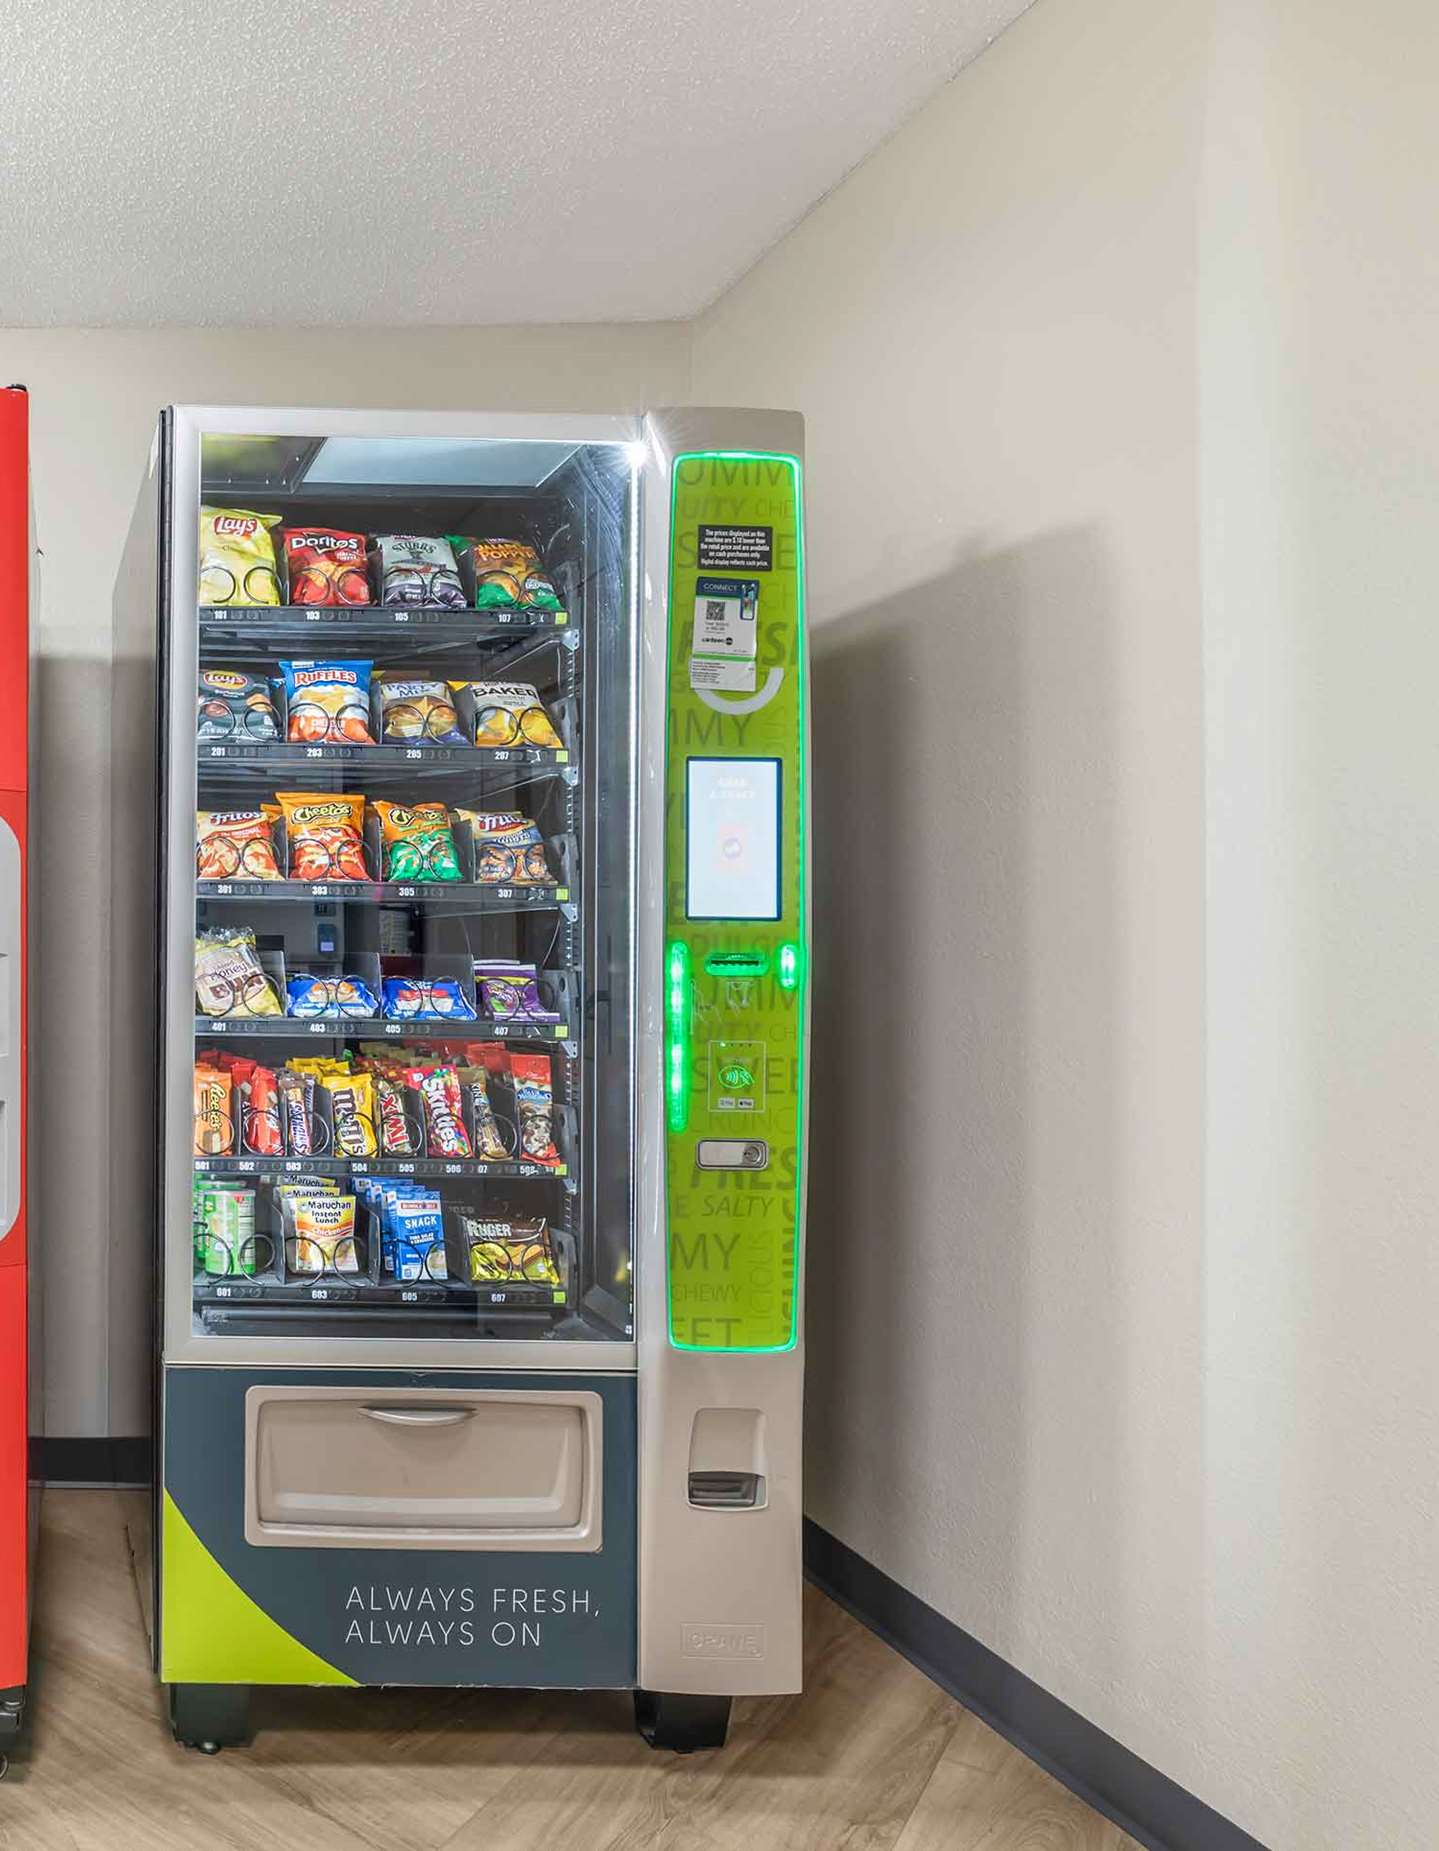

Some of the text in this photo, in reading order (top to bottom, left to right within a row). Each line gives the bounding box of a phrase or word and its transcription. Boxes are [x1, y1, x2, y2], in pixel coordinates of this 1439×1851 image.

[216, 516, 256, 535] Lay's
[292, 536, 358, 550] Doritos
[704, 583, 737, 591] CONNECT
[395, 612, 408, 620] 105
[499, 614, 511, 623] 107
[294, 670, 358, 687] RUFFLES
[474, 688, 536, 697] BAKED
[294, 804, 351, 823] Cheetos
[399, 888, 414, 896] 305
[498, 889, 512, 897] 307
[210, 961, 247, 981] Honey
[380, 1094, 408, 1151] TWIX
[423, 1078, 457, 1152] Skittles
[352, 1164, 367, 1172] 504
[308, 1200, 351, 1209] Maruchan
[701, 1194, 774, 1217] SALTY
[404, 1217, 437, 1229] SNACK
[673, 1282, 742, 1302] CHEWY
[345, 1586, 600, 1617] ALWAYS FRESH,
[345, 1620, 541, 1647] ALWAYS ON
